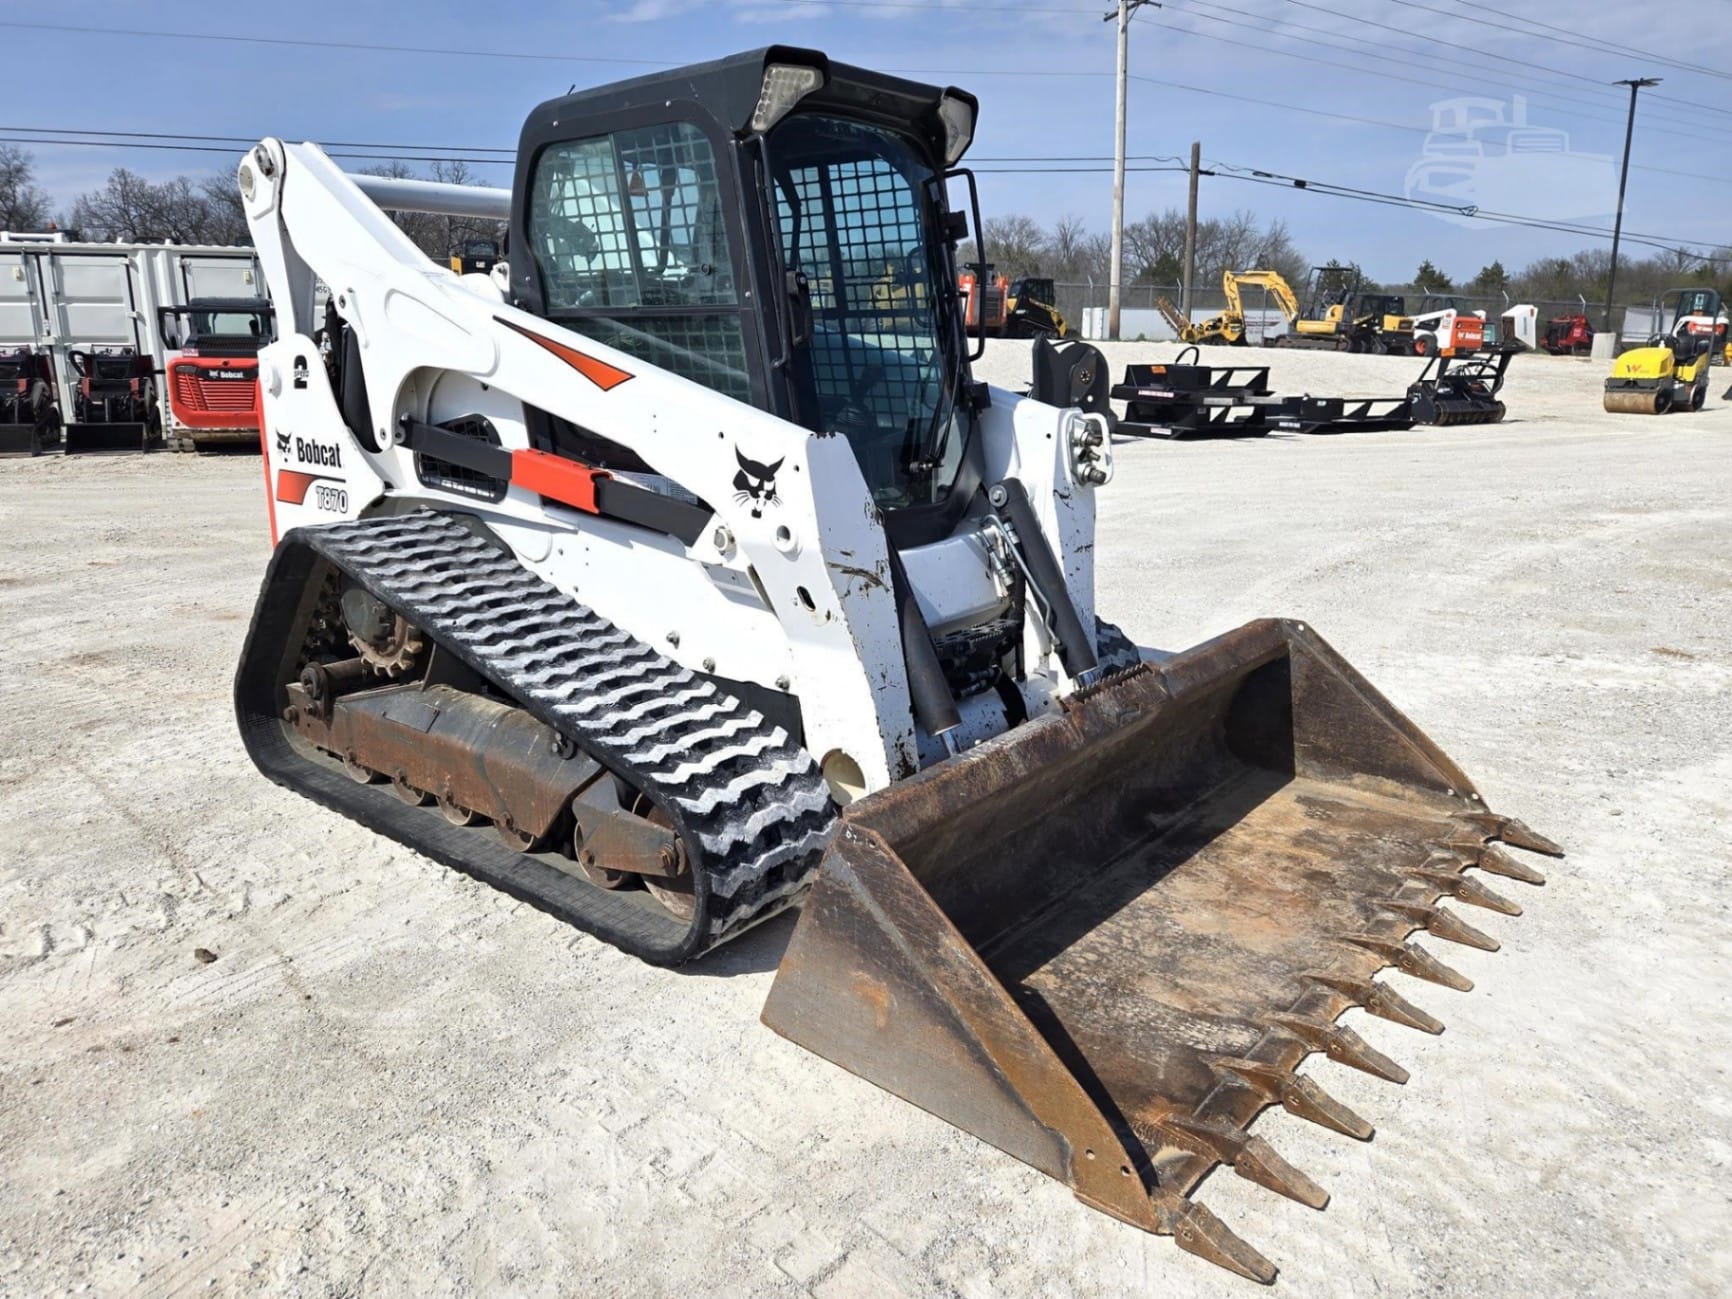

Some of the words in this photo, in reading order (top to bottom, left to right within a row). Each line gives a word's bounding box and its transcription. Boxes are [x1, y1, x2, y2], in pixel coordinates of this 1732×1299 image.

[220, 371, 244, 379] Bobcat
[296, 436, 342, 468] Bobcat
[315, 485, 349, 514] T870
